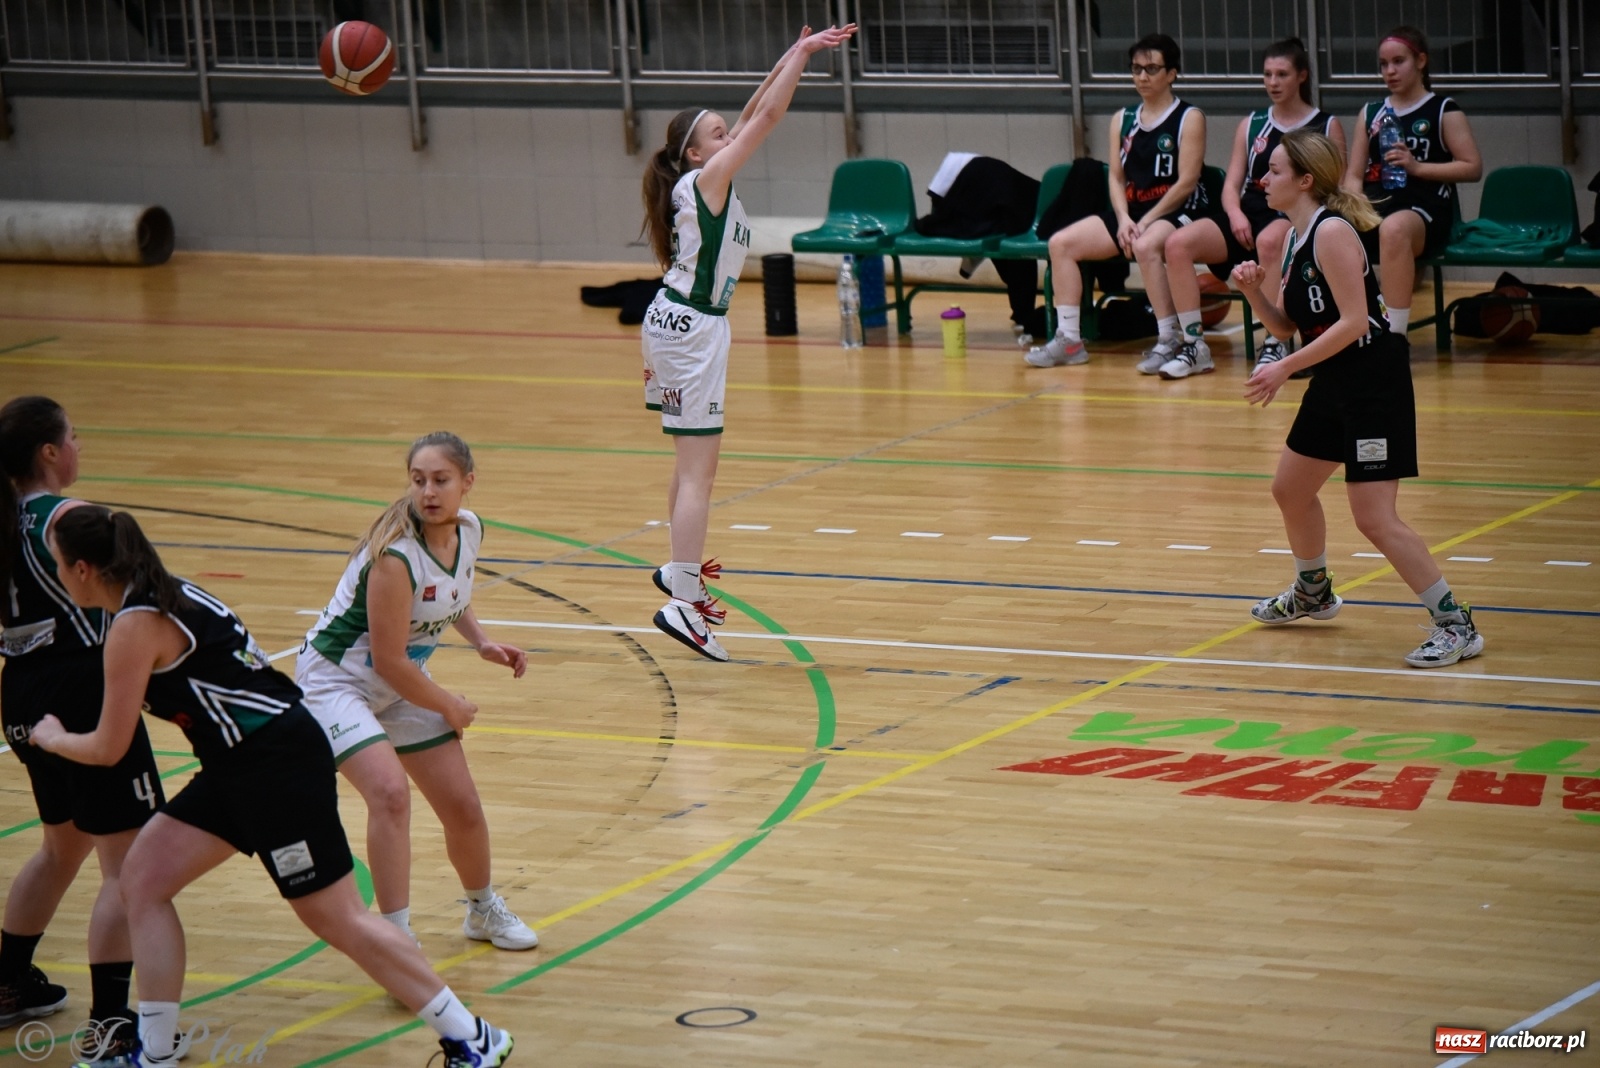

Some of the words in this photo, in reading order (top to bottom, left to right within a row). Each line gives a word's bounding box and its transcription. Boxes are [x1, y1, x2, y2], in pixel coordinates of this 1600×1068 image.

[1407, 137, 1430, 161] 23
[1155, 153, 1173, 177] 13
[1307, 284, 1326, 314] 8
[132, 771, 157, 810] 4
